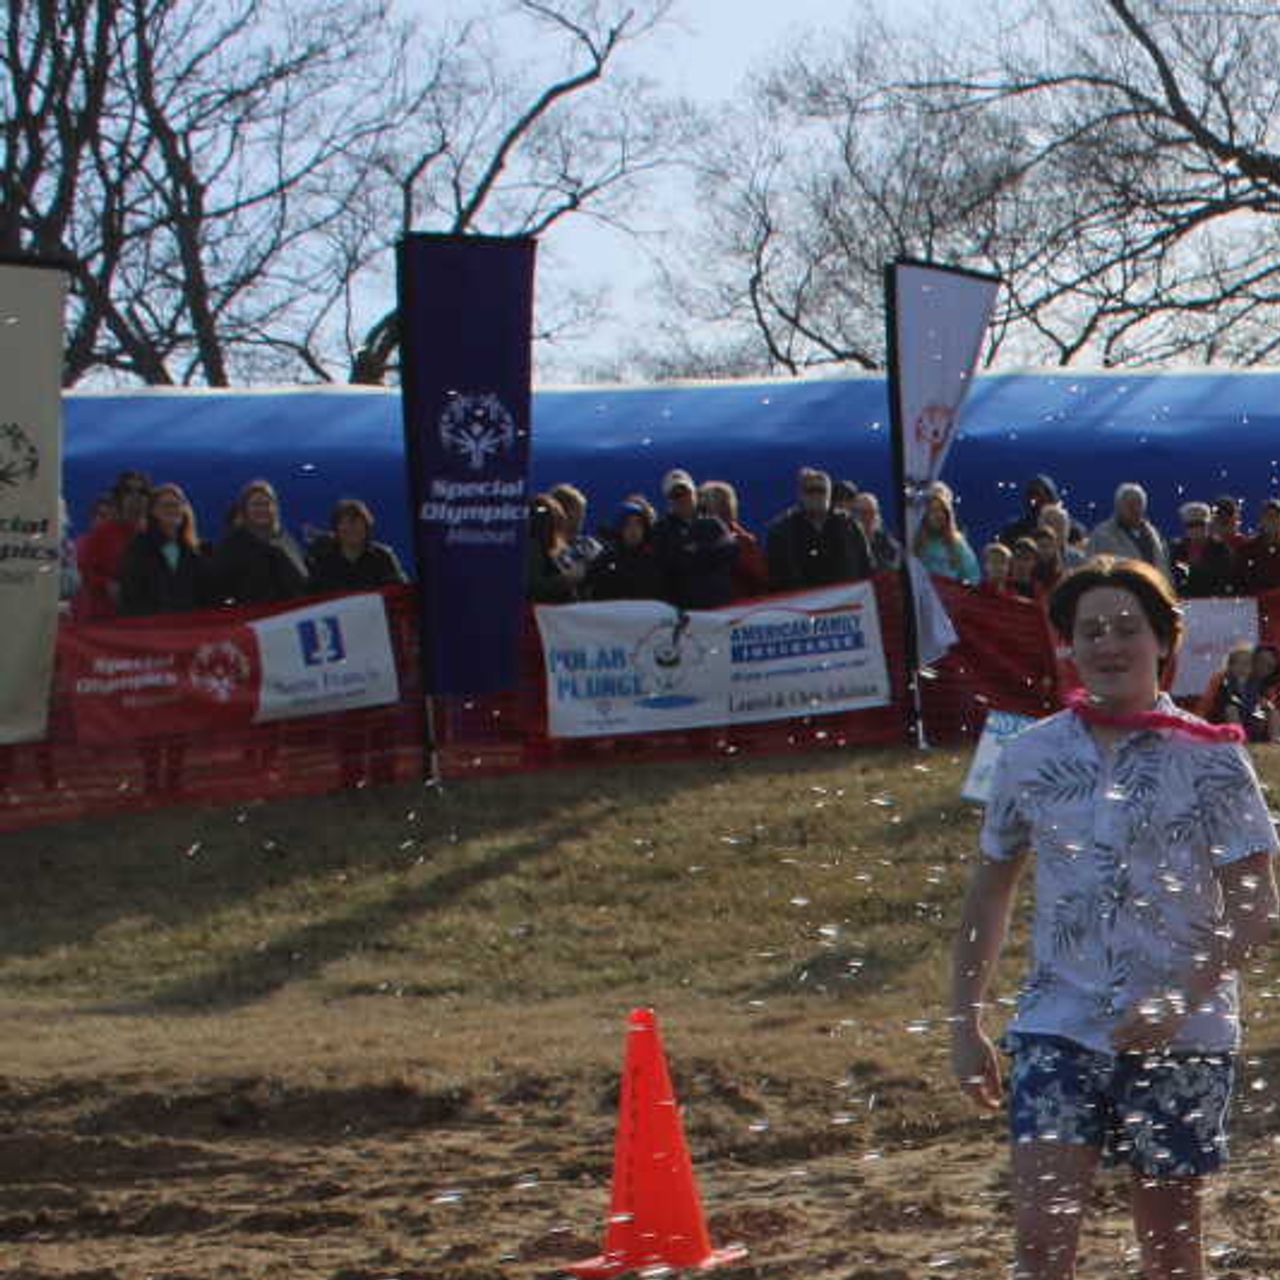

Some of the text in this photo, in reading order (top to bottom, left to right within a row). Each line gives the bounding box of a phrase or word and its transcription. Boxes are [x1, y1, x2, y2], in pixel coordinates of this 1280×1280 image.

[431, 480, 524, 500] Special
[420, 502, 531, 523] Olympics
[549, 646, 628, 673] POLAR
[557, 673, 645, 701] PLUNGE
